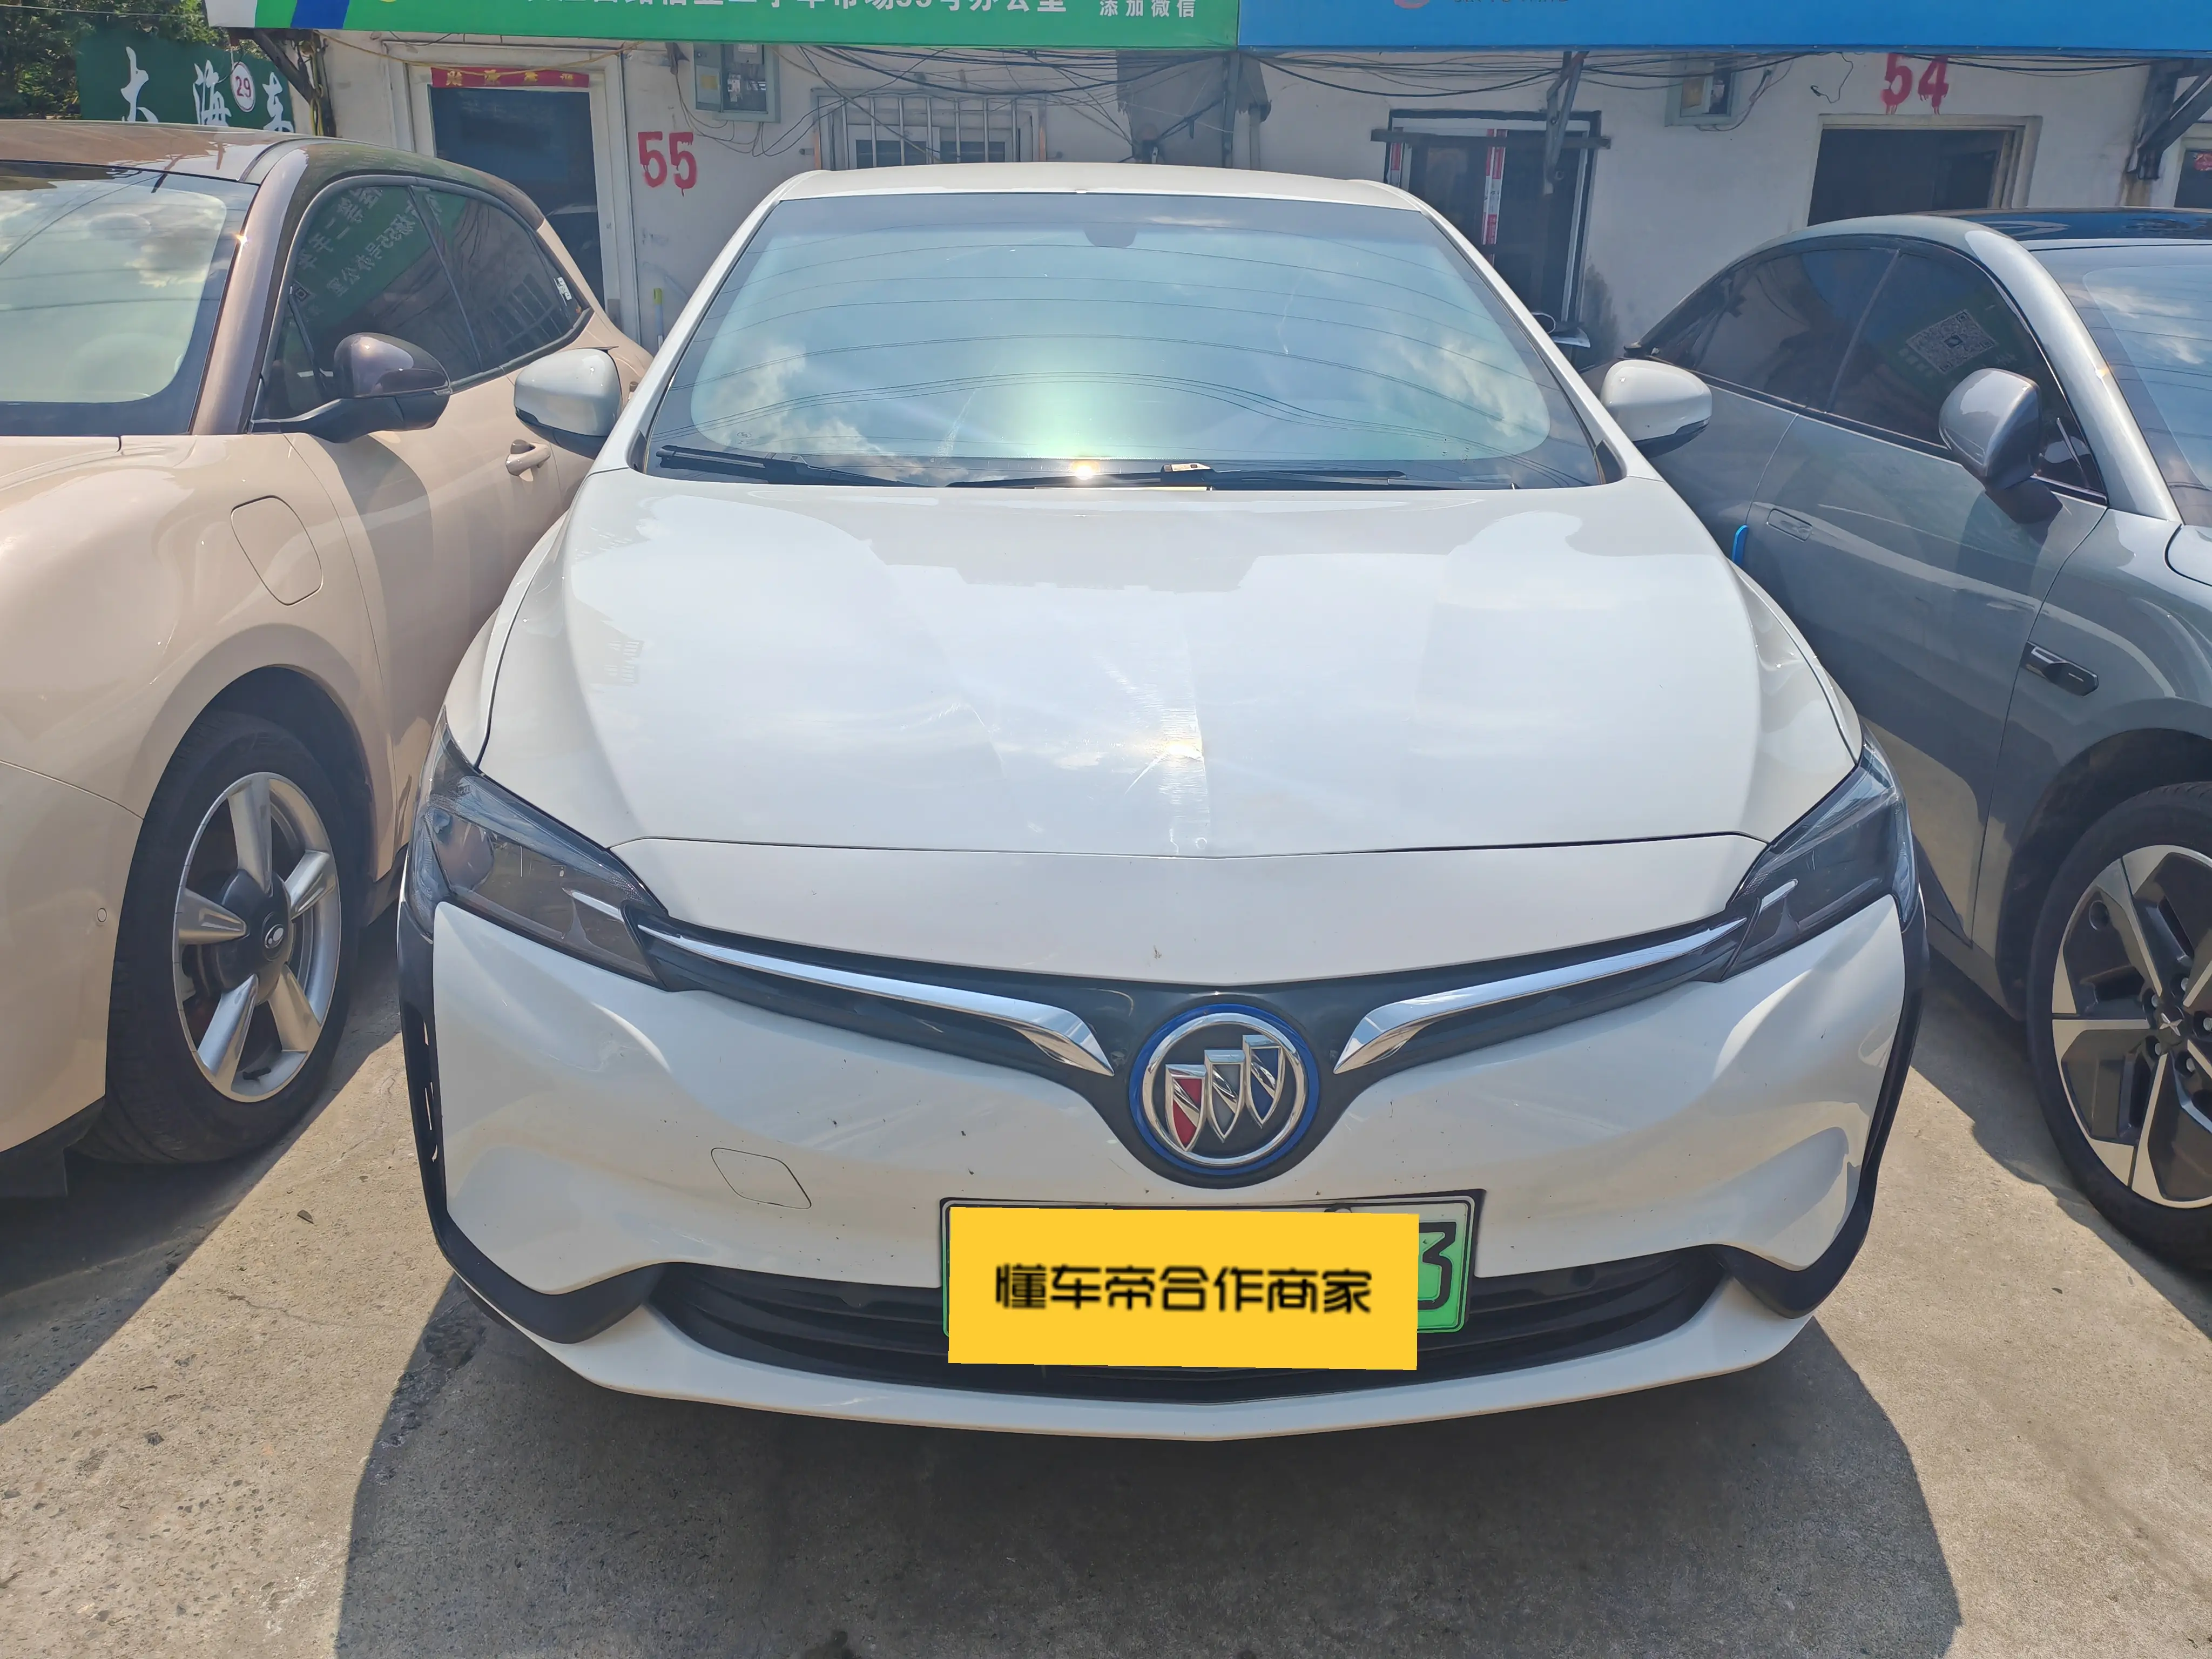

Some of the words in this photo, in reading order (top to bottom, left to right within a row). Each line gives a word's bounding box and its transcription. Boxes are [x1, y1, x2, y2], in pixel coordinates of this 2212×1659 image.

[1100, 0, 1196, 17] 添加微信
[235, 76, 252, 98] 29
[1881, 52, 1950, 114] 54
[638, 131, 697, 196] 55
[1418, 1222, 1456, 1310] 3
